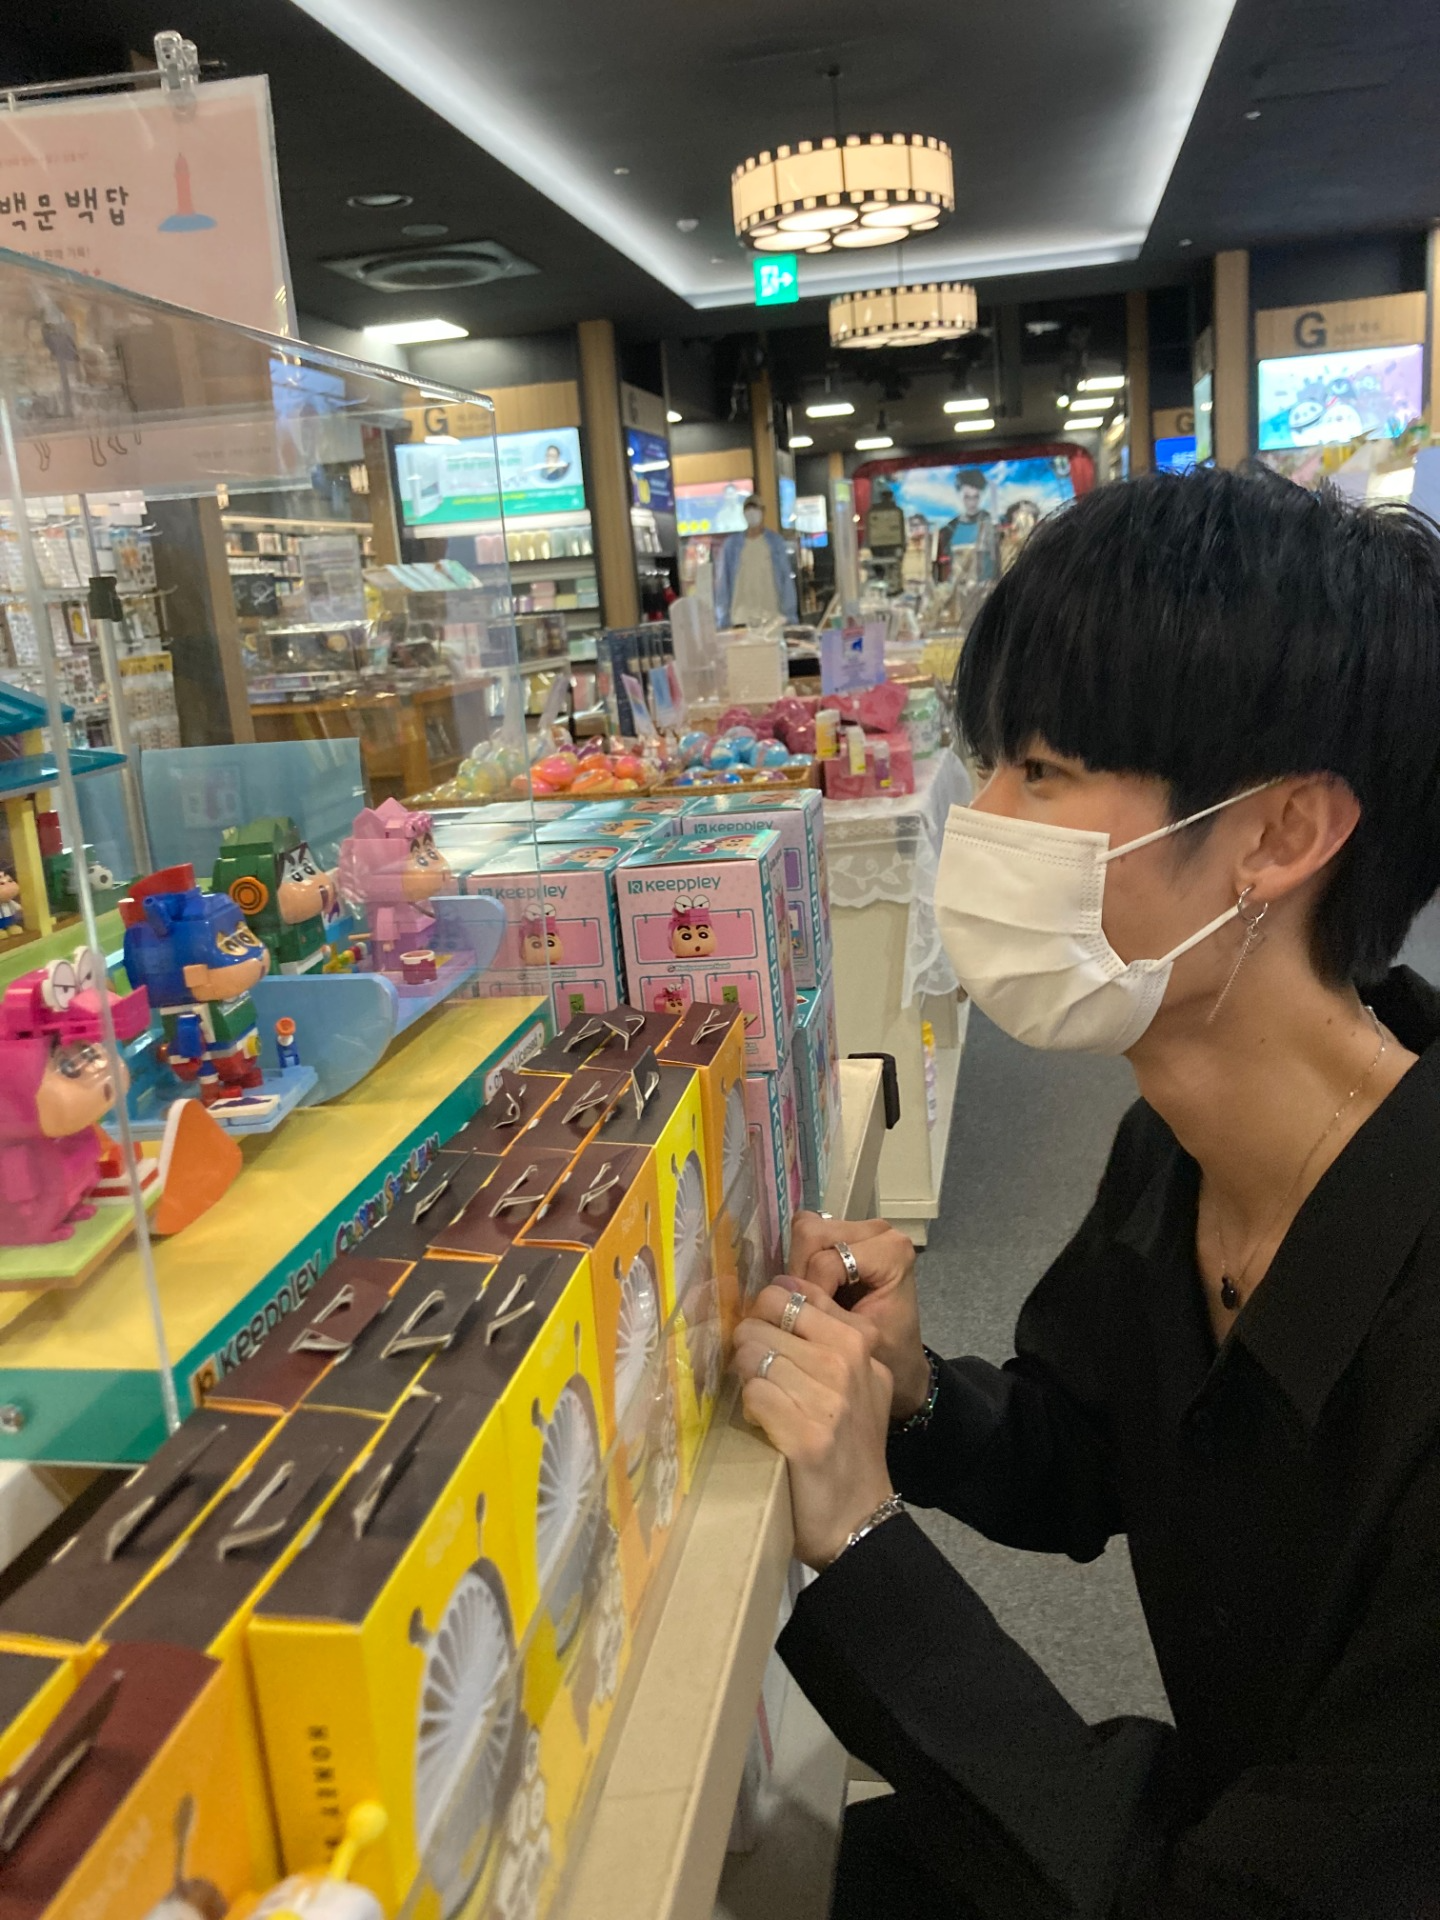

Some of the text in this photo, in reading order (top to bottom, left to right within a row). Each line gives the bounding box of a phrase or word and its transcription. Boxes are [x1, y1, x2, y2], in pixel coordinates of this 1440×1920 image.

[0, 186, 129, 231] 백문백답
[1294, 311, 1328, 348] G
[424, 406, 448, 435] G
